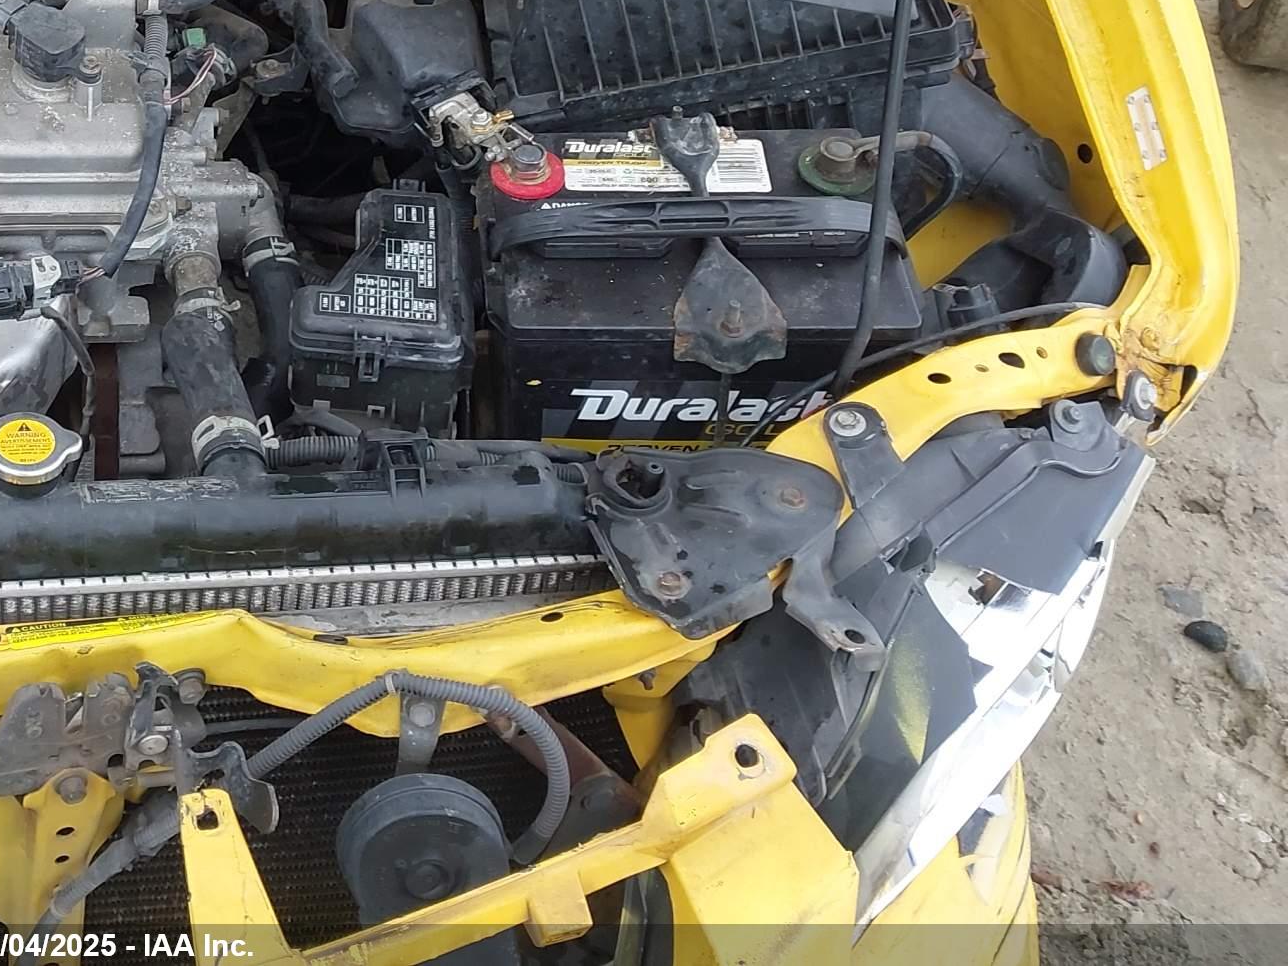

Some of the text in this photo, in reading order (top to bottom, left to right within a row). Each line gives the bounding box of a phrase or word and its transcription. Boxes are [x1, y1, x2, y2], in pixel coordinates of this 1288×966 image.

[565, 141, 655, 154] Duralast
[571, 388, 833, 423] Duralast
[20, 622, 67, 633] CAUTION
